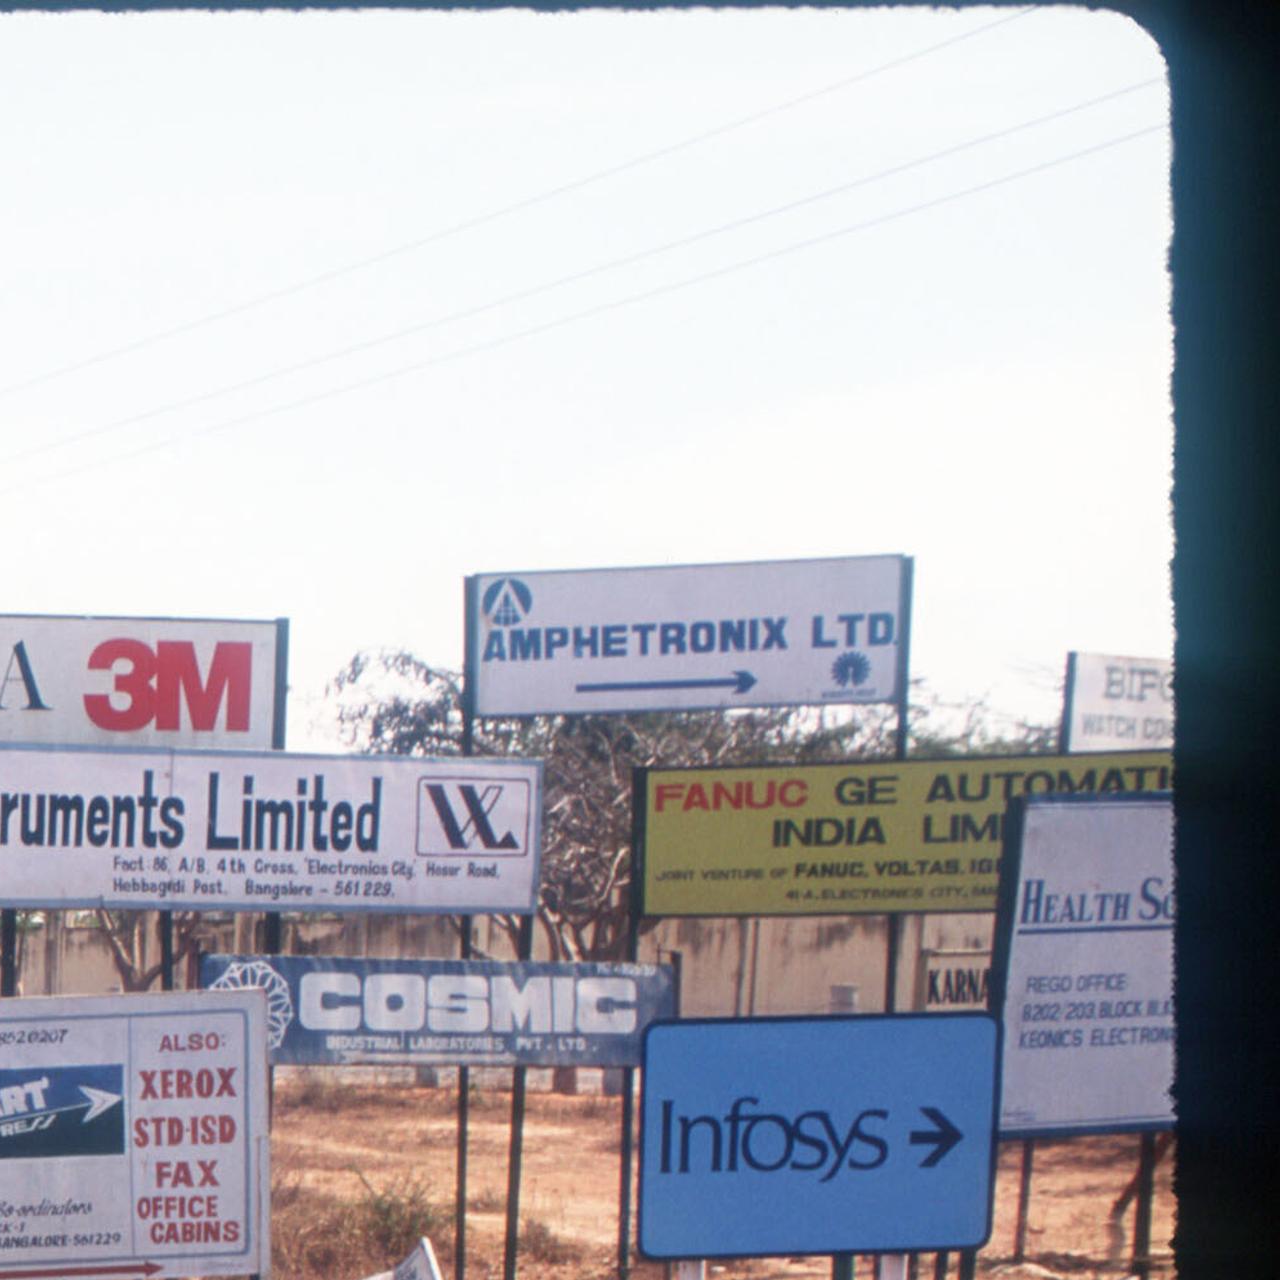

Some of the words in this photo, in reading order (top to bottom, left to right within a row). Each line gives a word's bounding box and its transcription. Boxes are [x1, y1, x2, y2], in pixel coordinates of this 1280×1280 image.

[482, 616, 788, 663] AMPHETRONIX
[83, 637, 254, 734] 3M
[654, 779, 809, 812] FANUC
[834, 775, 899, 804] GE
[204, 771, 384, 853] Limited
[771, 814, 887, 848] INDIA
[426, 861, 461, 877] Hosur
[244, 880, 313, 900] Bangalore
[1019, 879, 1133, 925] HEALTH
[1076, 973, 1128, 992] OFFICE
[298, 971, 638, 1035] COSMIC
[325, 1036, 402, 1050] INDUSTRIAL
[1018, 1028, 1085, 1050] KEONICS
[139, 1067, 239, 1100] XEROX
[659, 1095, 890, 1183] Infosys
[155, 1159, 221, 1190] FAX
[137, 1195, 219, 1221] OFFICE
[150, 1220, 240, 1246] CABINS
